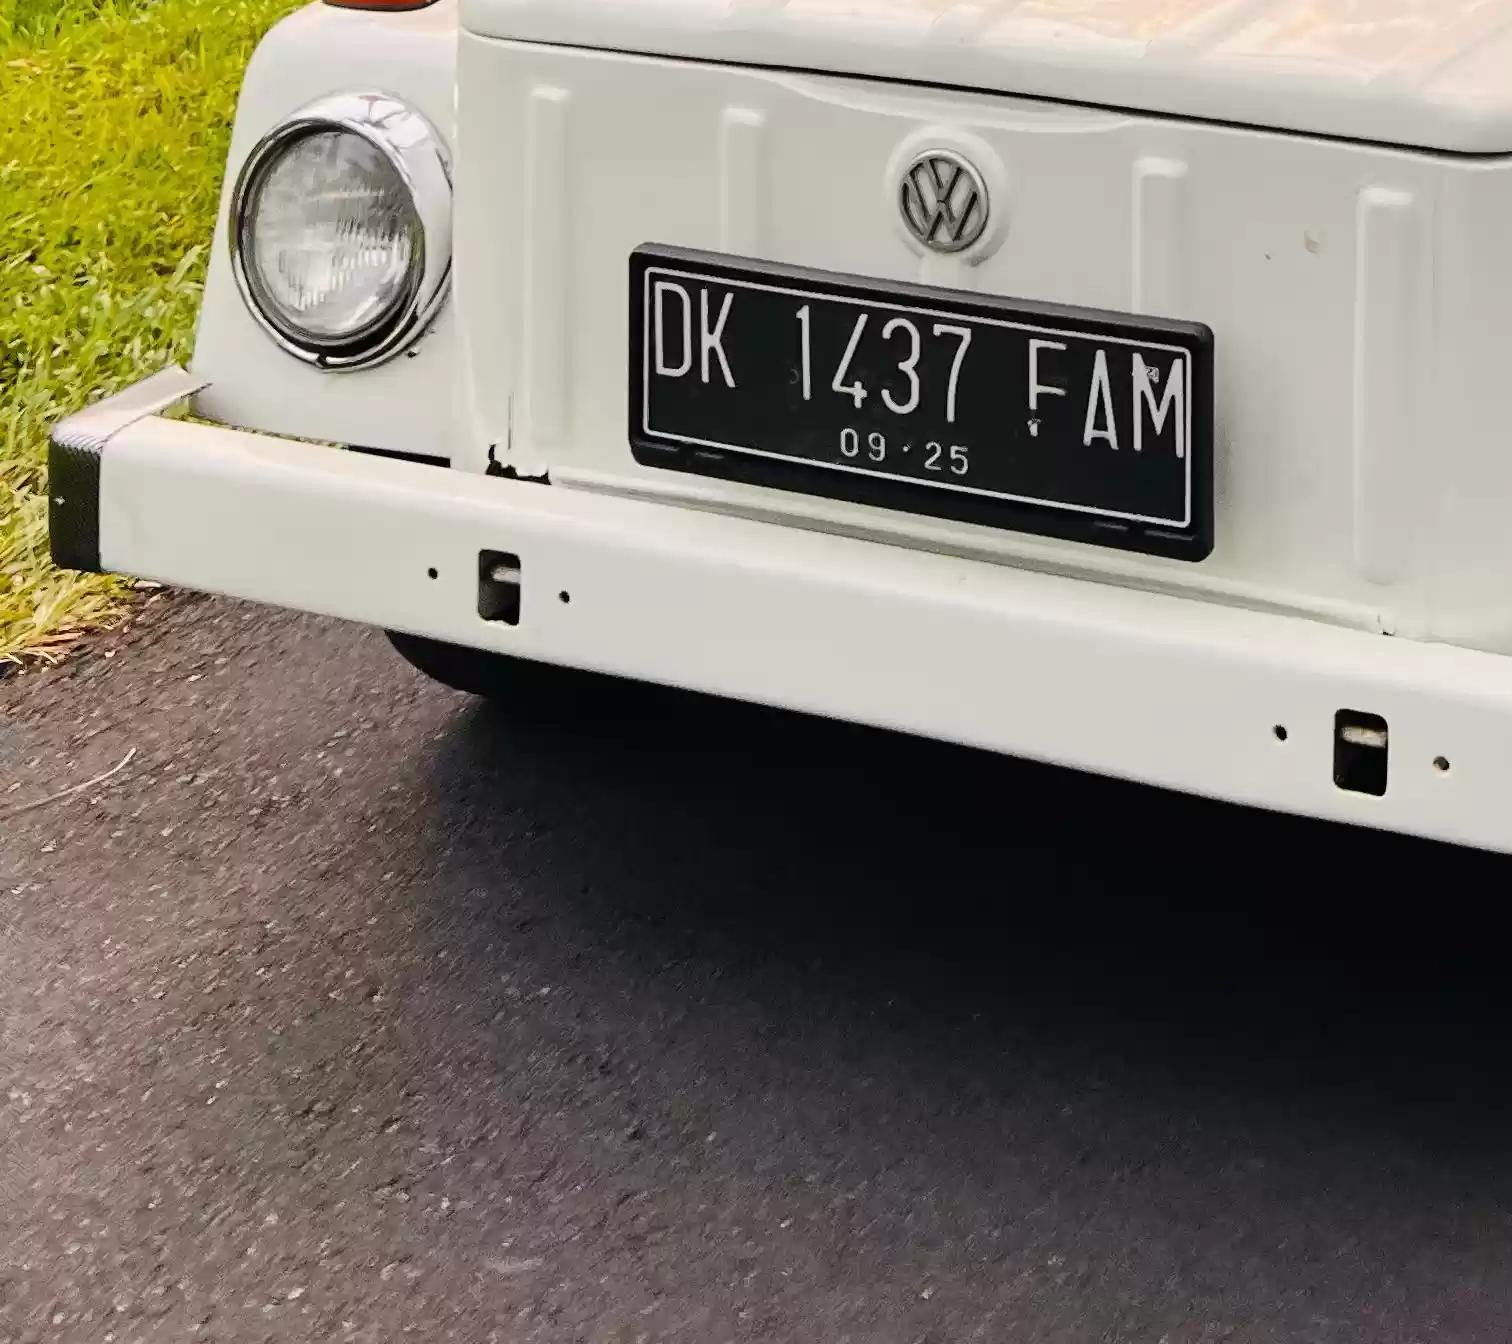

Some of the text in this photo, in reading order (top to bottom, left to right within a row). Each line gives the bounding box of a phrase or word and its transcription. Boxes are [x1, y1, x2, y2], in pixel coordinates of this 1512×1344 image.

[901, 150, 988, 252] VW
[654, 281, 1185, 459] DK 1437 FAM
